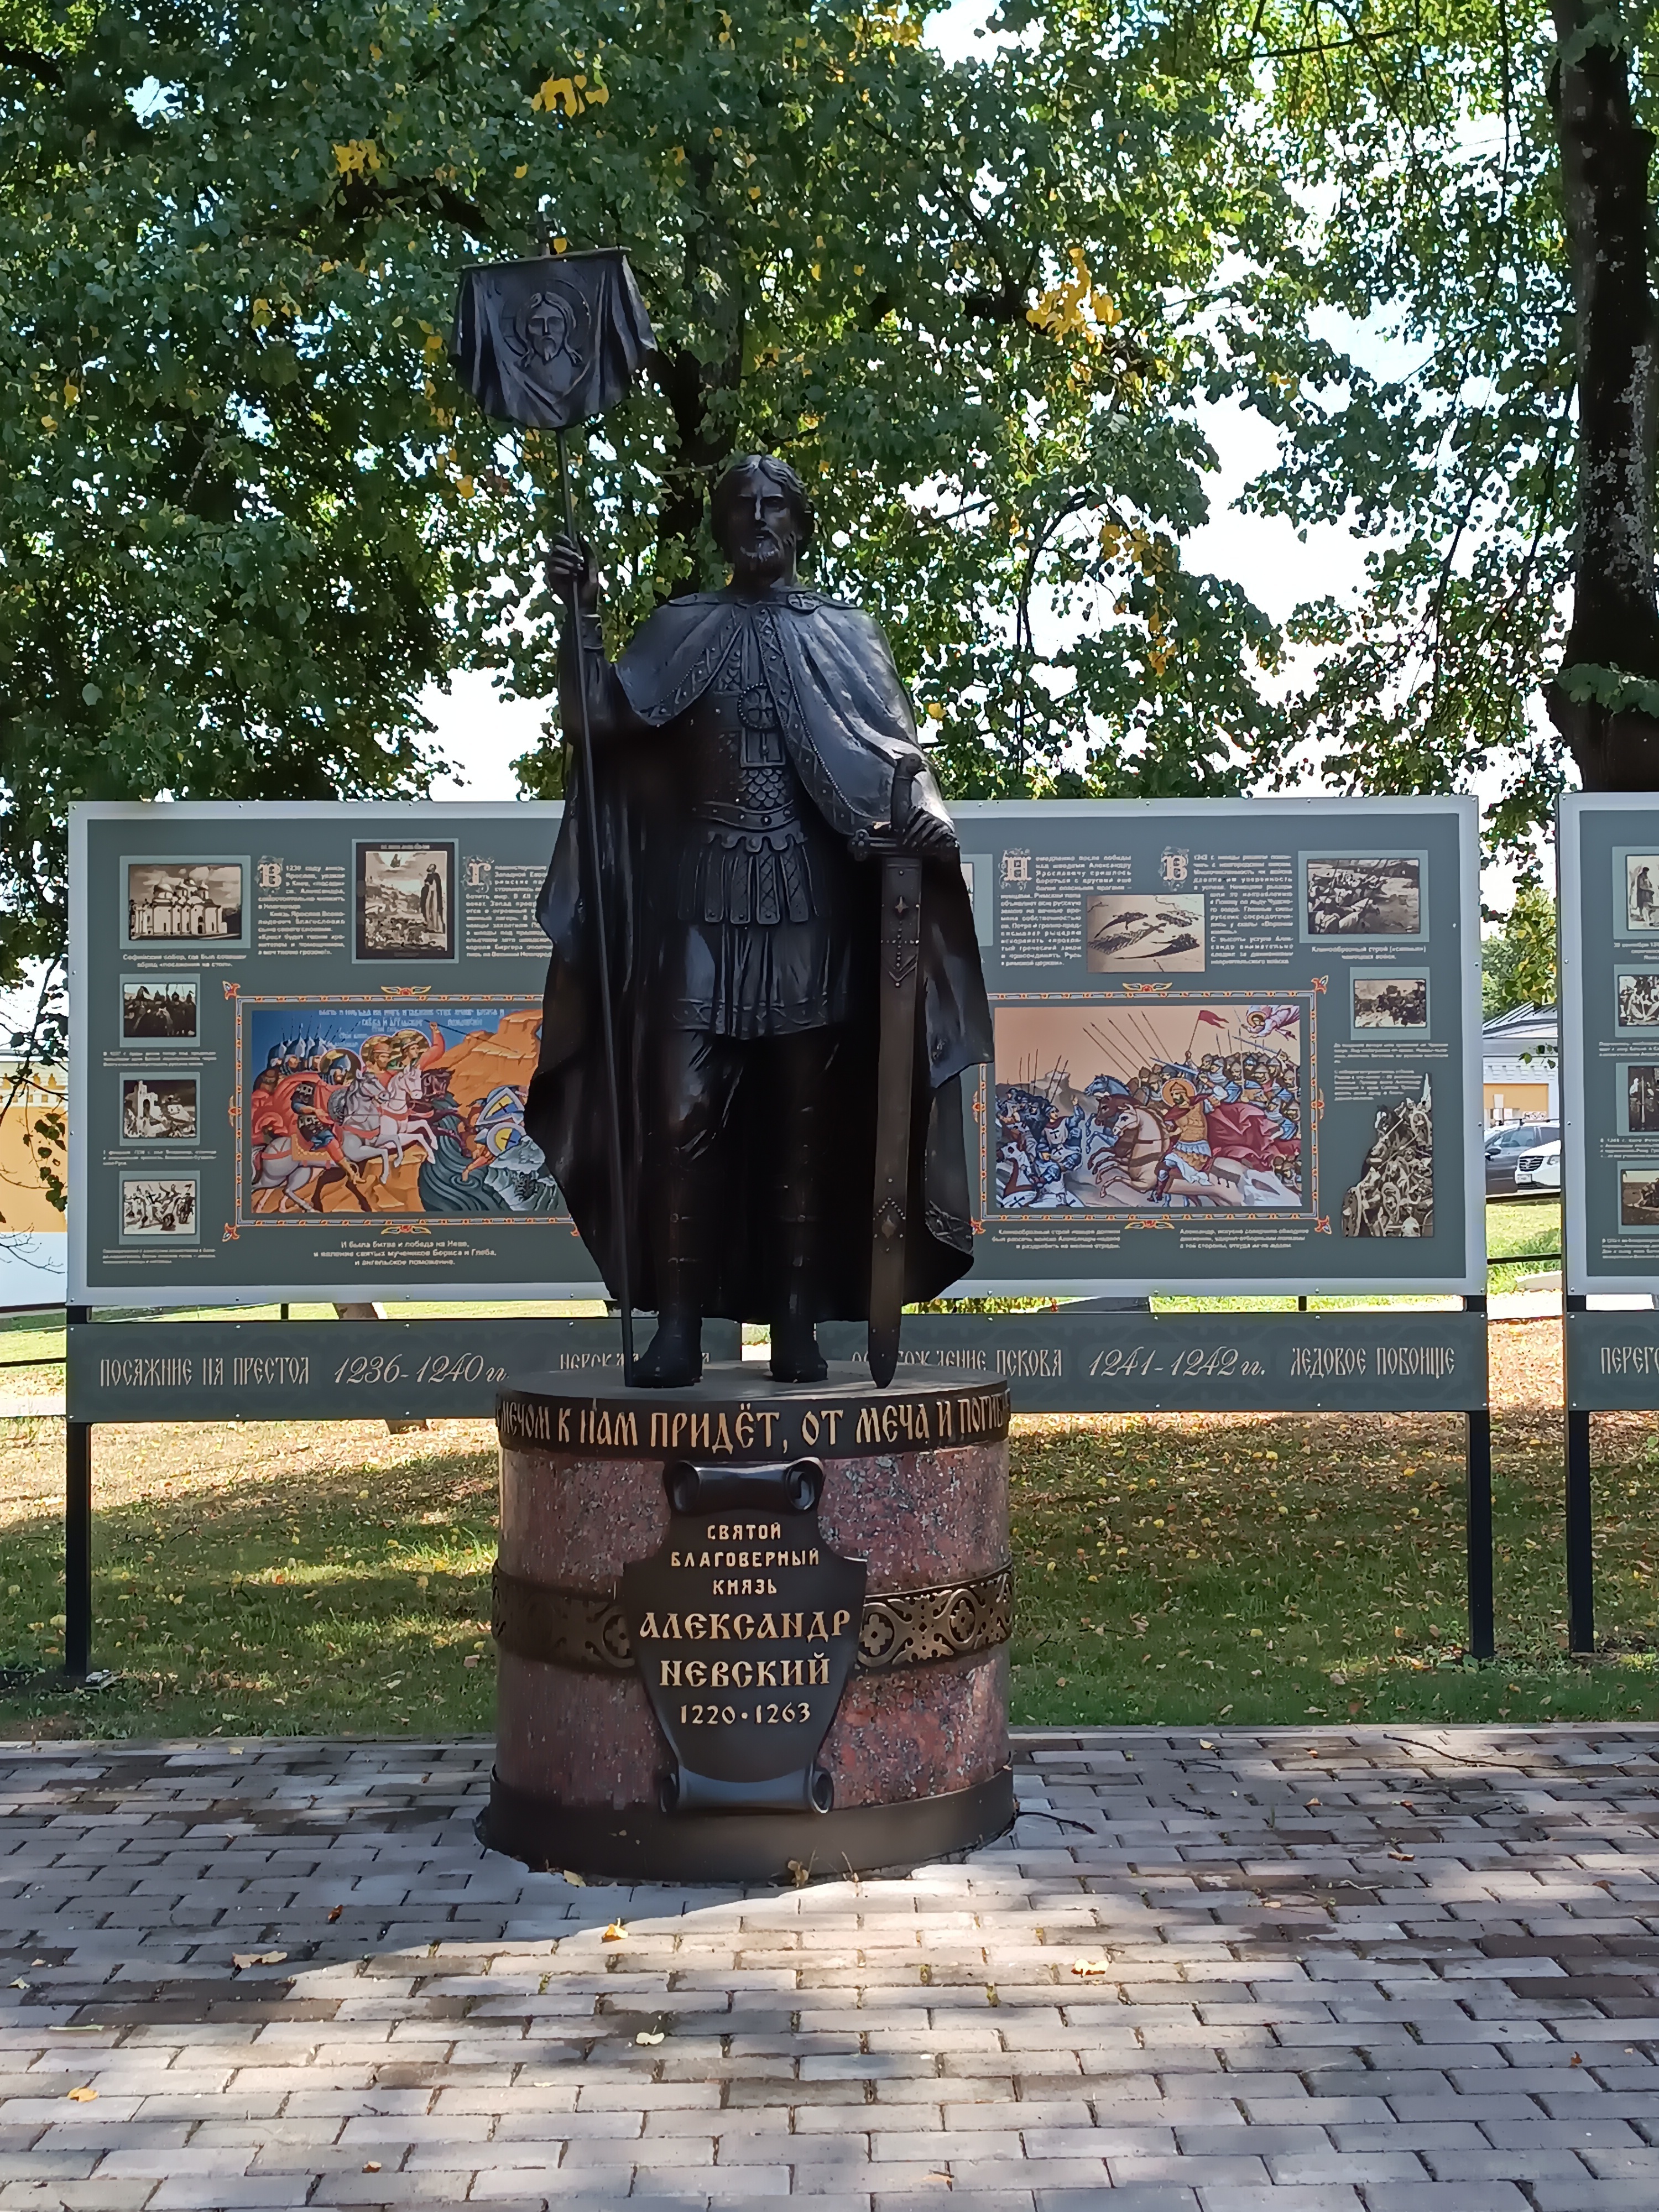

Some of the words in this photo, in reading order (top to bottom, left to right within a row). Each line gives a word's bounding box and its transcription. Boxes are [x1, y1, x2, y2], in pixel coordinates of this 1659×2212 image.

[203, 1358, 223, 1385] НА
[233, 1357, 309, 1385] ПРЕСТОЛ
[997, 1349, 1062, 1377] ПСКОВА
[1291, 1348, 1366, 1379] ЛЕДОВОЕ
[1376, 1347, 1456, 1379] ПОБОИЩЕ
[501, 1400, 550, 1440] МЕЧОМ
[559, 1407, 572, 1442] К
[580, 1410, 638, 1446] НАМ
[650, 1402, 788, 1454] ПРИДЁТ,
[802, 1410, 843, 1446] ОТ
[856, 1404, 930, 1443] МЕЧА
[936, 1401, 952, 1437] И
[707, 1522, 781, 1540] СВЯТОЙ
[671, 1548, 819, 1569] БЛАГОВЕРНЫЙ
[713, 1578, 777, 1595] КНЯЗЬ
[640, 1609, 851, 1643] АЛЕКСАНДР
[659, 1652, 831, 1688] НЕВСКИЙ
